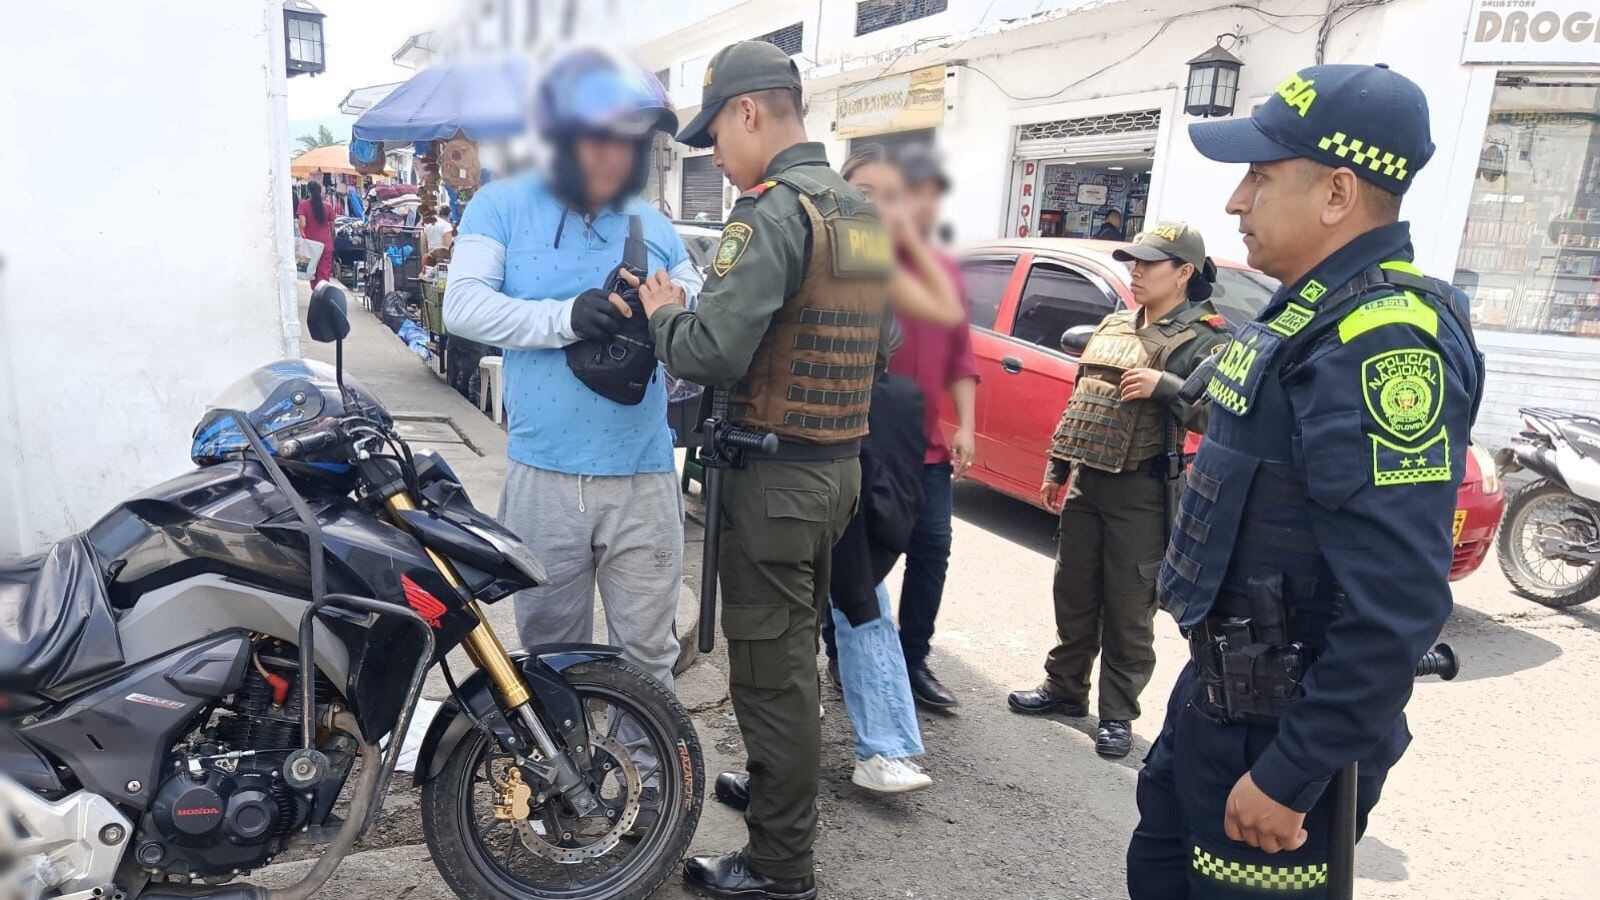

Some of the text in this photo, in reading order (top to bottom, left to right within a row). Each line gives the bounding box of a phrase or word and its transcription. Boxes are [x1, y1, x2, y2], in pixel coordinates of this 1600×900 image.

[1474, 10, 1600, 43] DROG
[1375, 353, 1431, 373] POLICÍA
[1368, 365, 1437, 390] NACIONAL
[176, 806, 220, 816] HONDA
